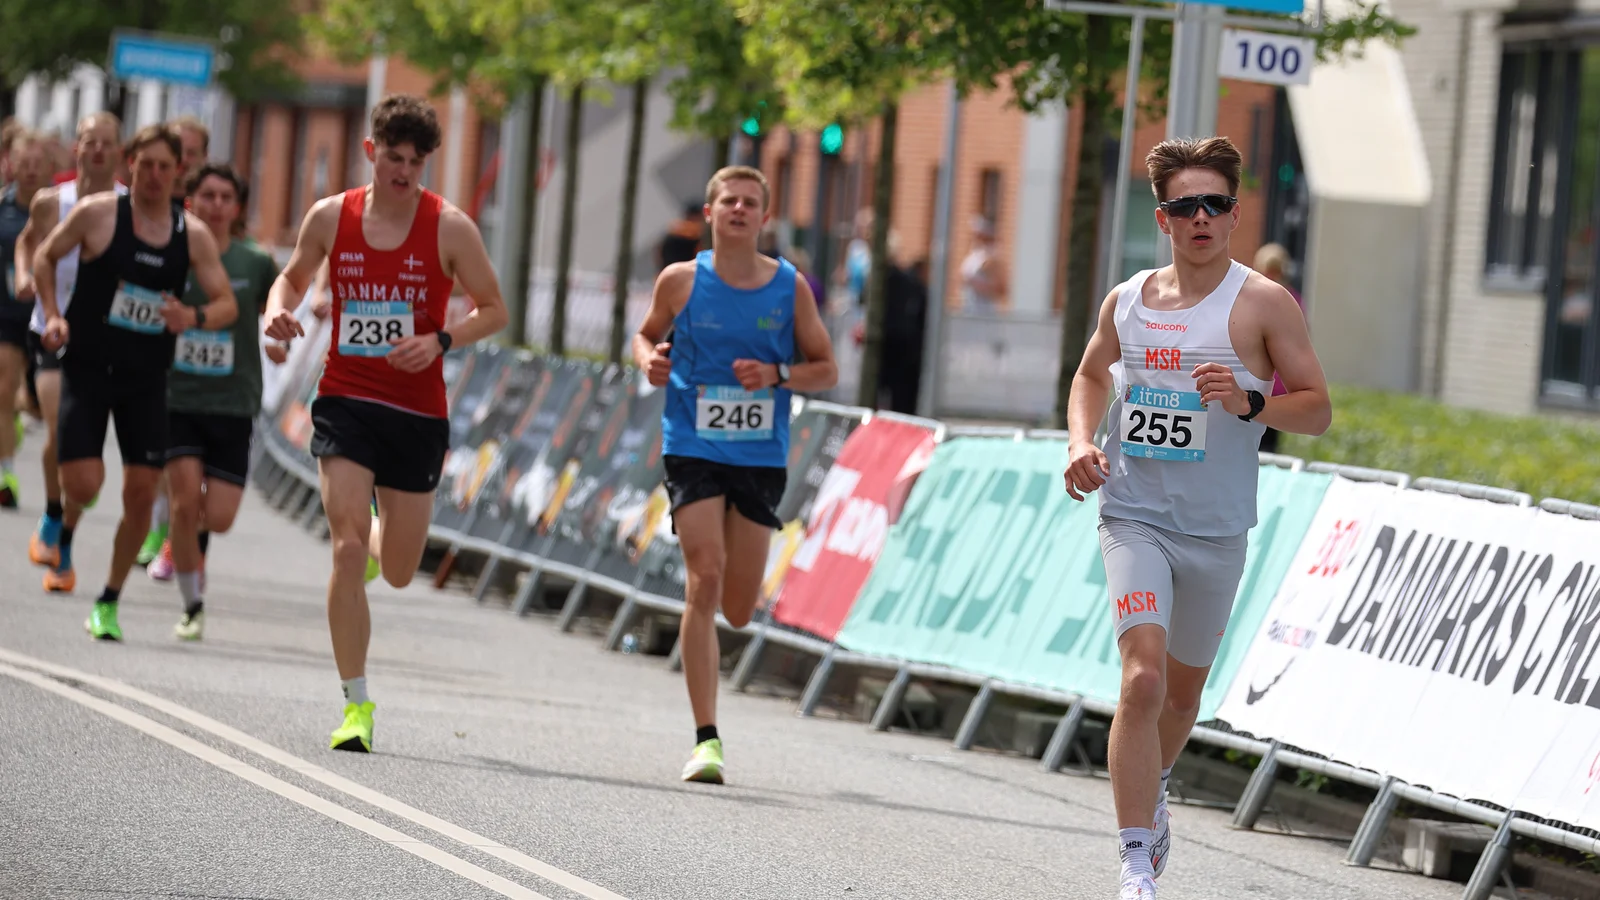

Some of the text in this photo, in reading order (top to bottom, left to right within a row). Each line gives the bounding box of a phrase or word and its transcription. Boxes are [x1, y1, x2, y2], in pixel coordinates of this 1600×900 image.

[1237, 40, 1302, 77] 100
[337, 282, 428, 303] DANMARK
[348, 319, 404, 346] 238
[1145, 321, 1189, 333] saucony
[182, 340, 226, 367] 242
[1145, 347, 1182, 371] MSR
[1139, 387, 1181, 408] itm8
[707, 404, 764, 430] 246
[1127, 409, 1193, 448] 255
[1116, 591, 1158, 620] MSR
[1325, 524, 1554, 687] DANMARKS
[1125, 840, 1143, 850] MSR
